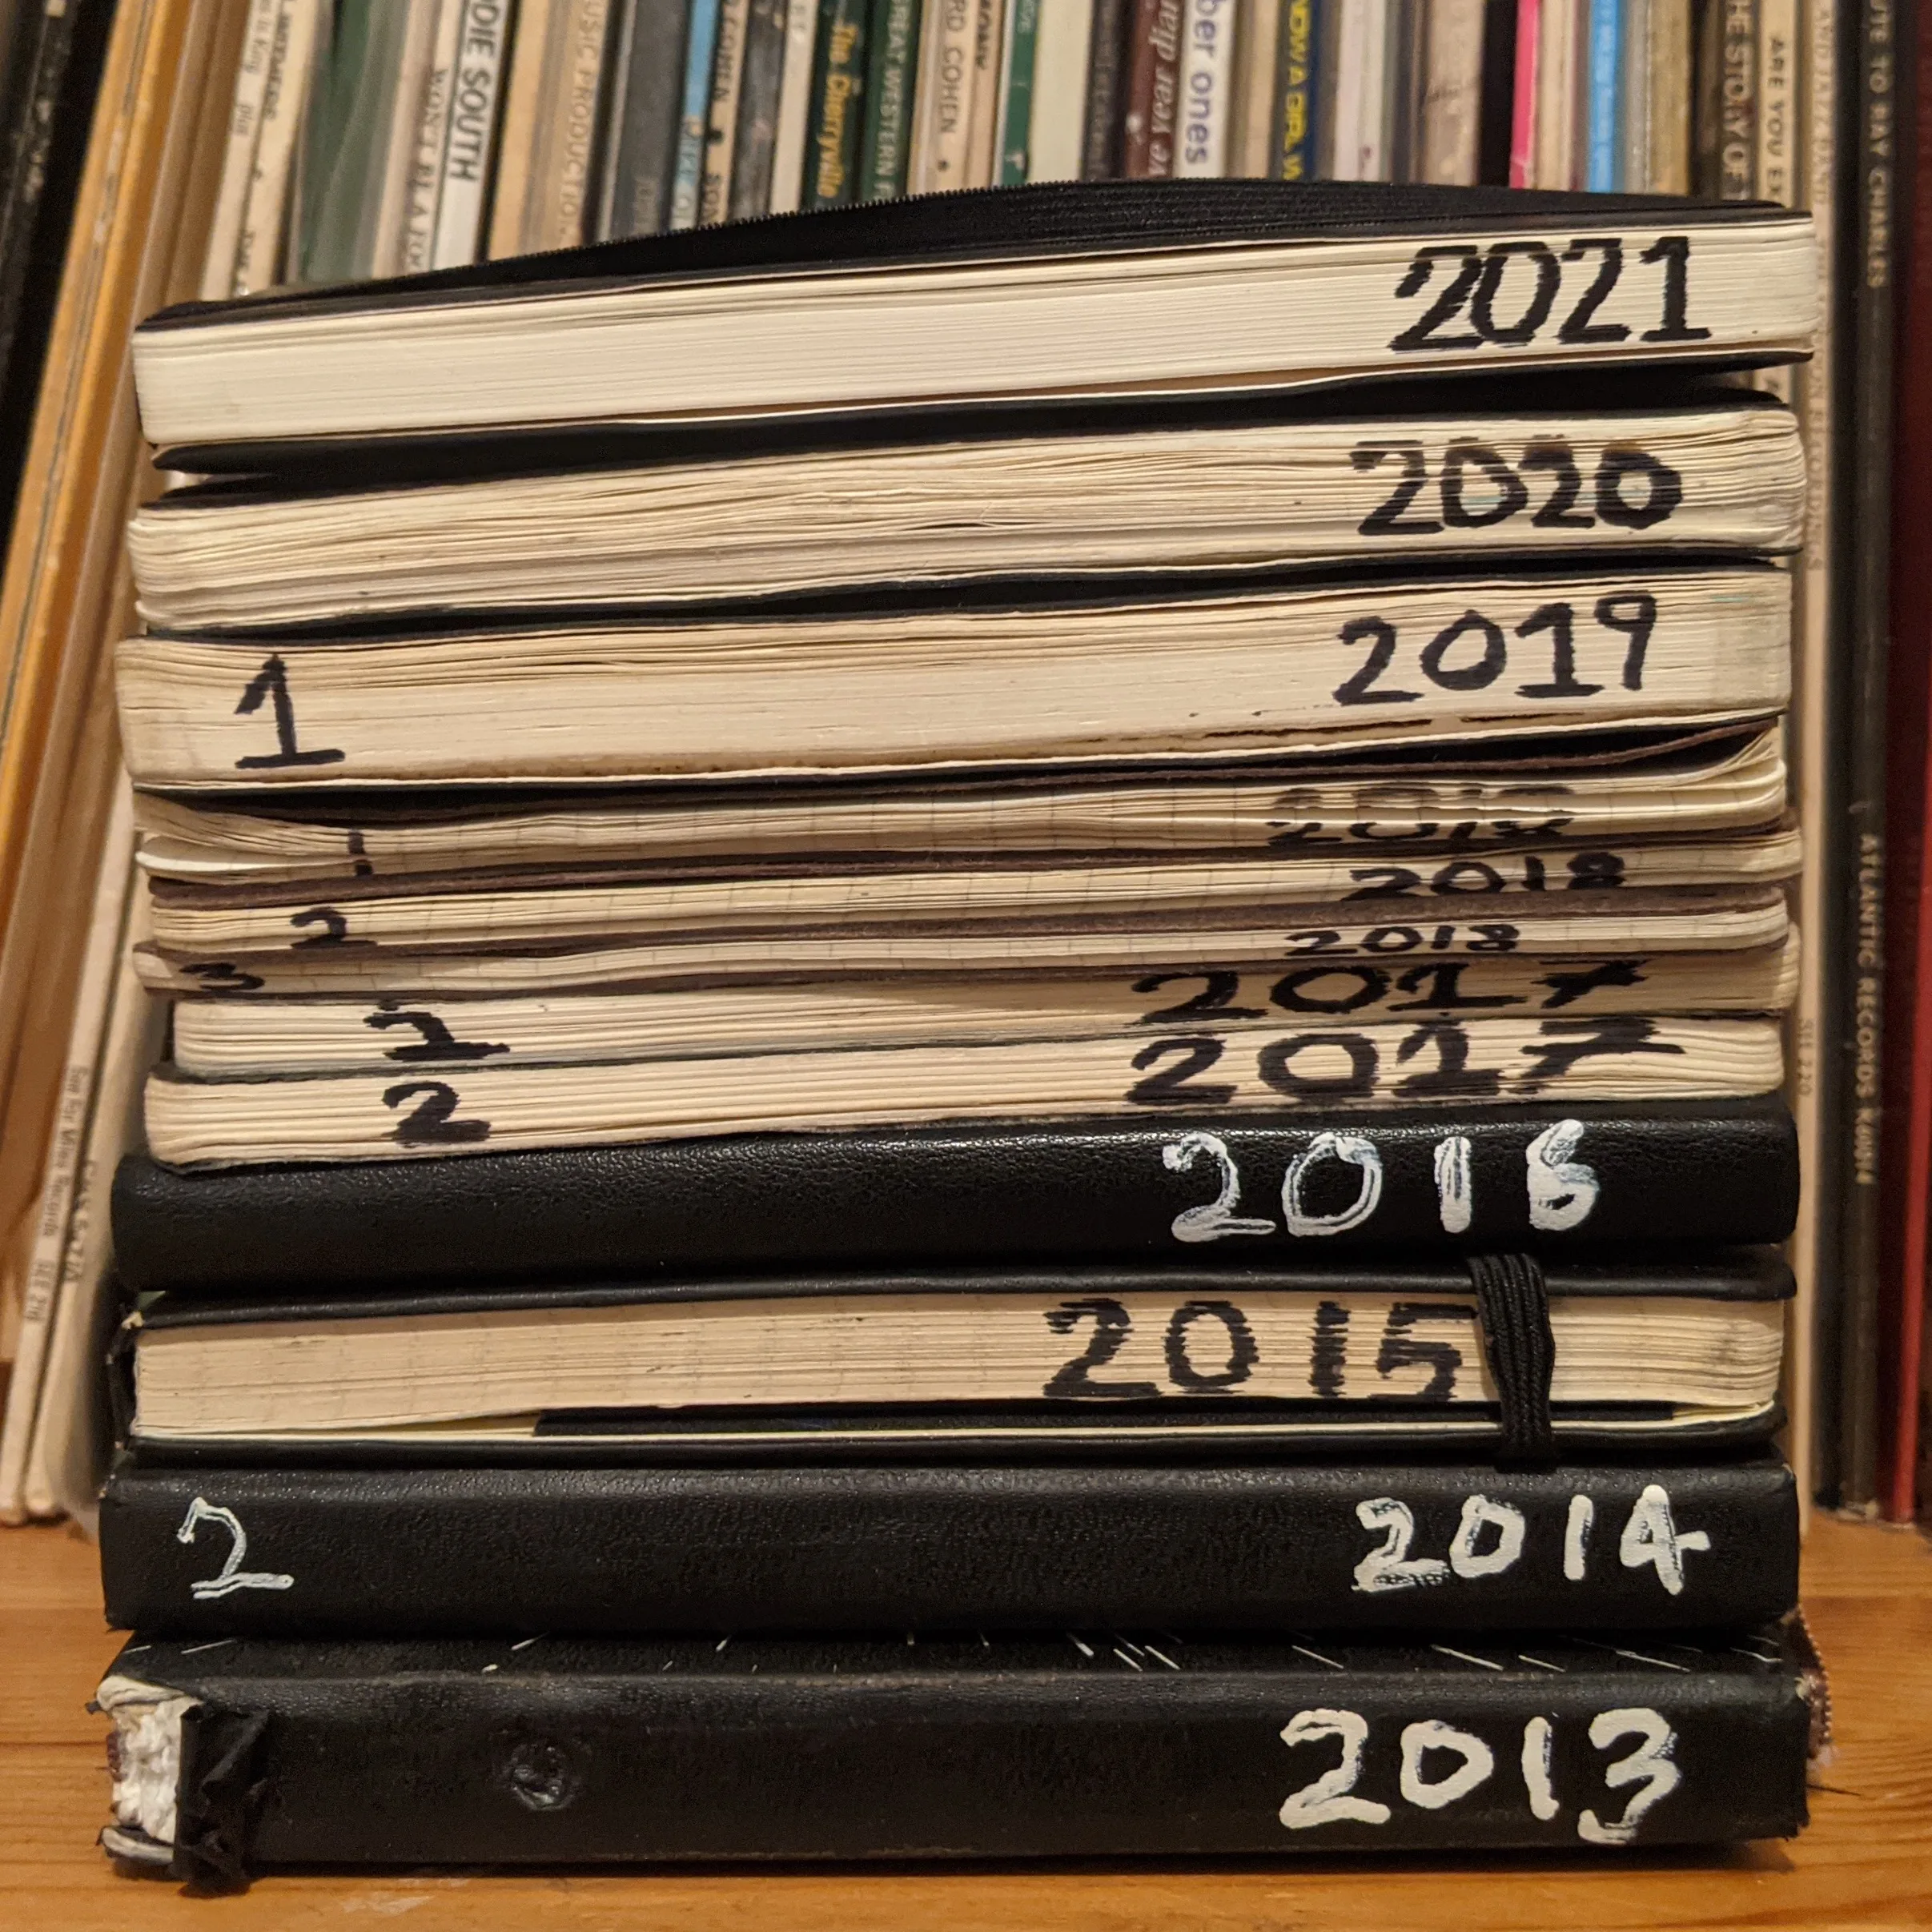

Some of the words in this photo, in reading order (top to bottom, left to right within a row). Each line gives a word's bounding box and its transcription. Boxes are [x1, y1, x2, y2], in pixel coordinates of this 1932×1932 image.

[940, 47, 964, 133] COHEN
[1724, 42, 1753, 139] STORY
[1767, 37, 1785, 88] ARE
[1869, 54, 1891, 94] TO
[451, 67, 489, 181] SOUTH
[875, 64, 903, 176] WESTERN
[1184, 71, 1213, 165] ones
[1766, 102, 1785, 157] YOU
[1869, 102, 1891, 157] RAY
[1866, 167, 1890, 289] CHARLES
[1388, 235, 1712, 353] 2021
[1349, 435, 1682, 536] 2020
[1333, 590, 1657, 706] 2019
[234, 652, 345, 769] 1
[1342, 851, 1627, 902] 2018
[1858, 833, 1882, 968] ATLANTIC
[1282, 923, 1520, 957] 2018
[1123, 1015, 1686, 1105] 2017
[1855, 977, 1880, 1098] RECORDS
[381, 1081, 491, 1148] 2
[1163, 1119, 1600, 1243] 2016
[1042, 1297, 1481, 1402] 2015
[177, 1496, 295, 1600] 2
[1351, 1485, 1712, 1595] 2014
[1279, 1707, 1681, 1845] 2013
